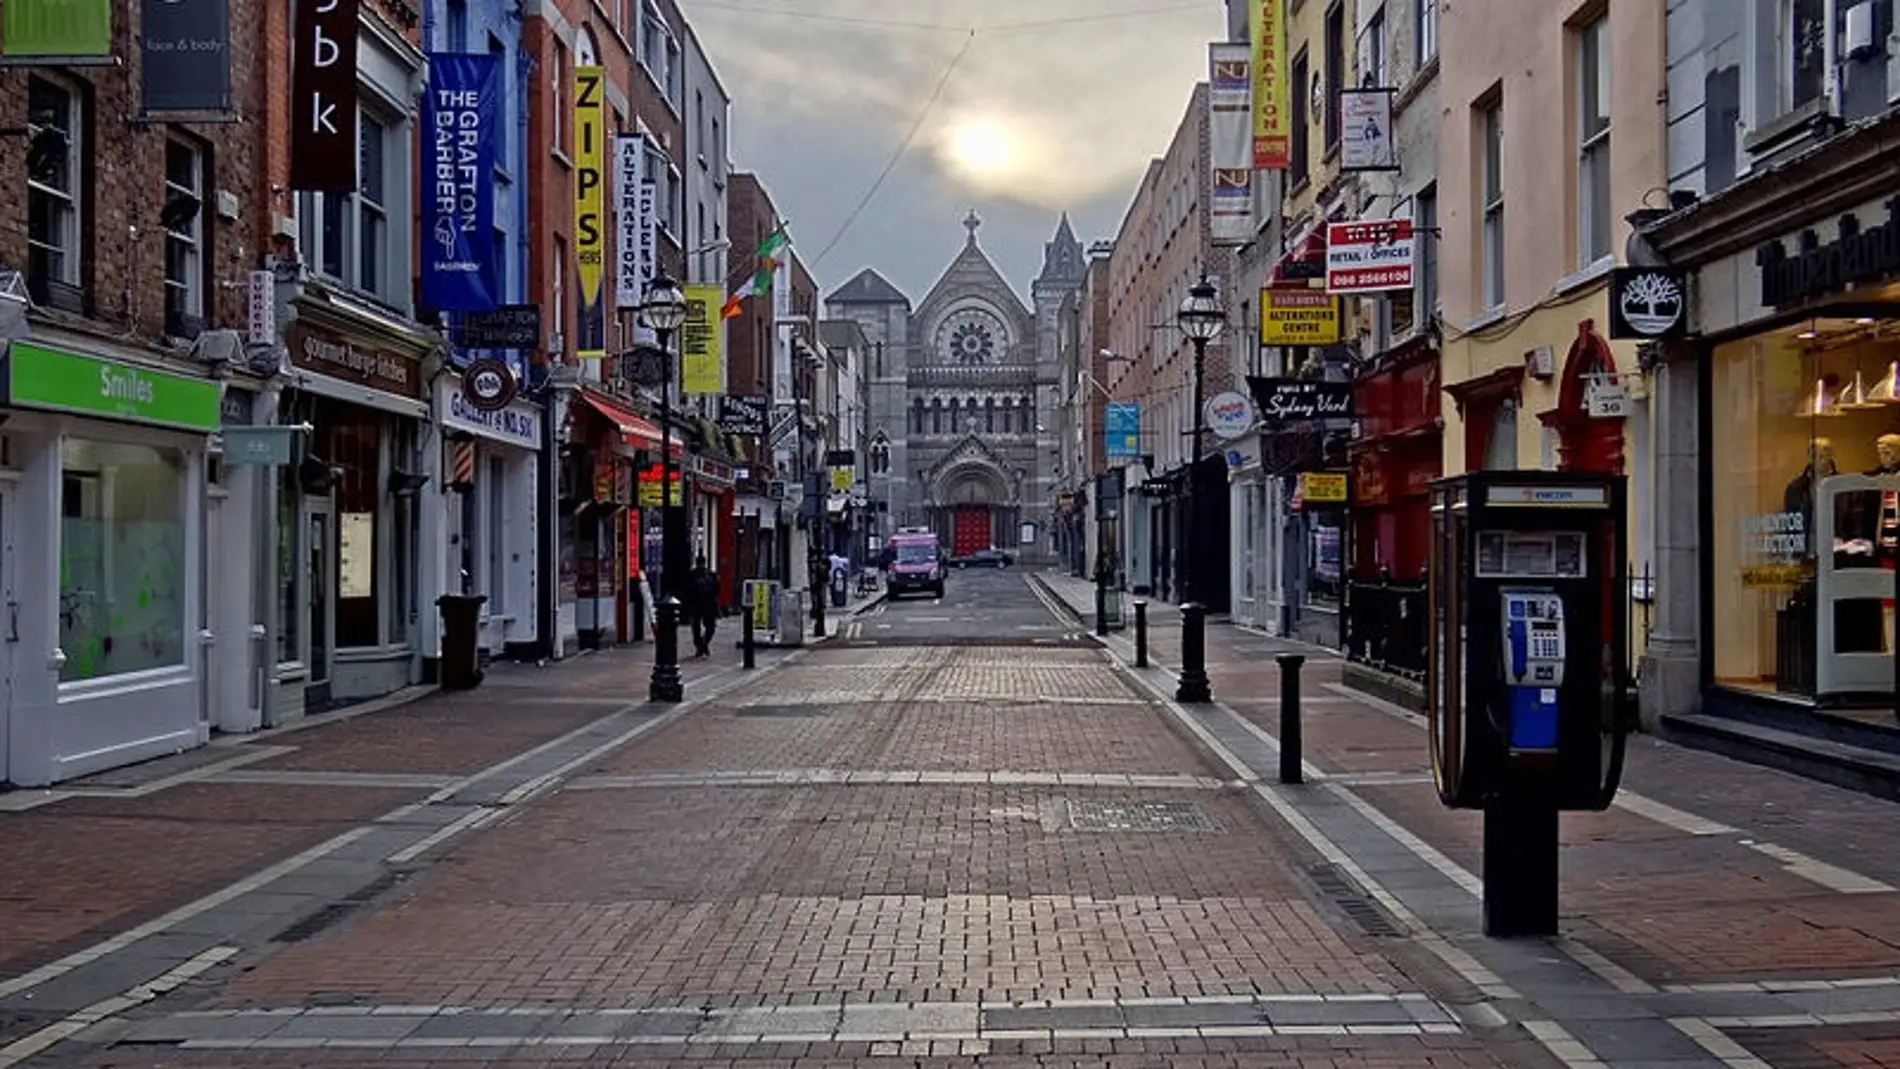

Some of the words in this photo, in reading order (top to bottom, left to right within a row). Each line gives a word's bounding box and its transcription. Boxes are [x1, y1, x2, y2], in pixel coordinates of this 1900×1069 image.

[177, 39, 188, 51] &
[191, 38, 222, 54] body
[311, 0, 339, 134] bk
[438, 90, 479, 108] THE
[436, 111, 456, 214] BARBER
[458, 110, 479, 232] GRAFTON
[577, 76, 599, 245] ZIPS
[623, 143, 636, 290] ALTERATIONS
[1330, 252, 1362, 262] RETAIL
[1370, 247, 1410, 260] OFFICES
[101, 365, 152, 402] Smiles
